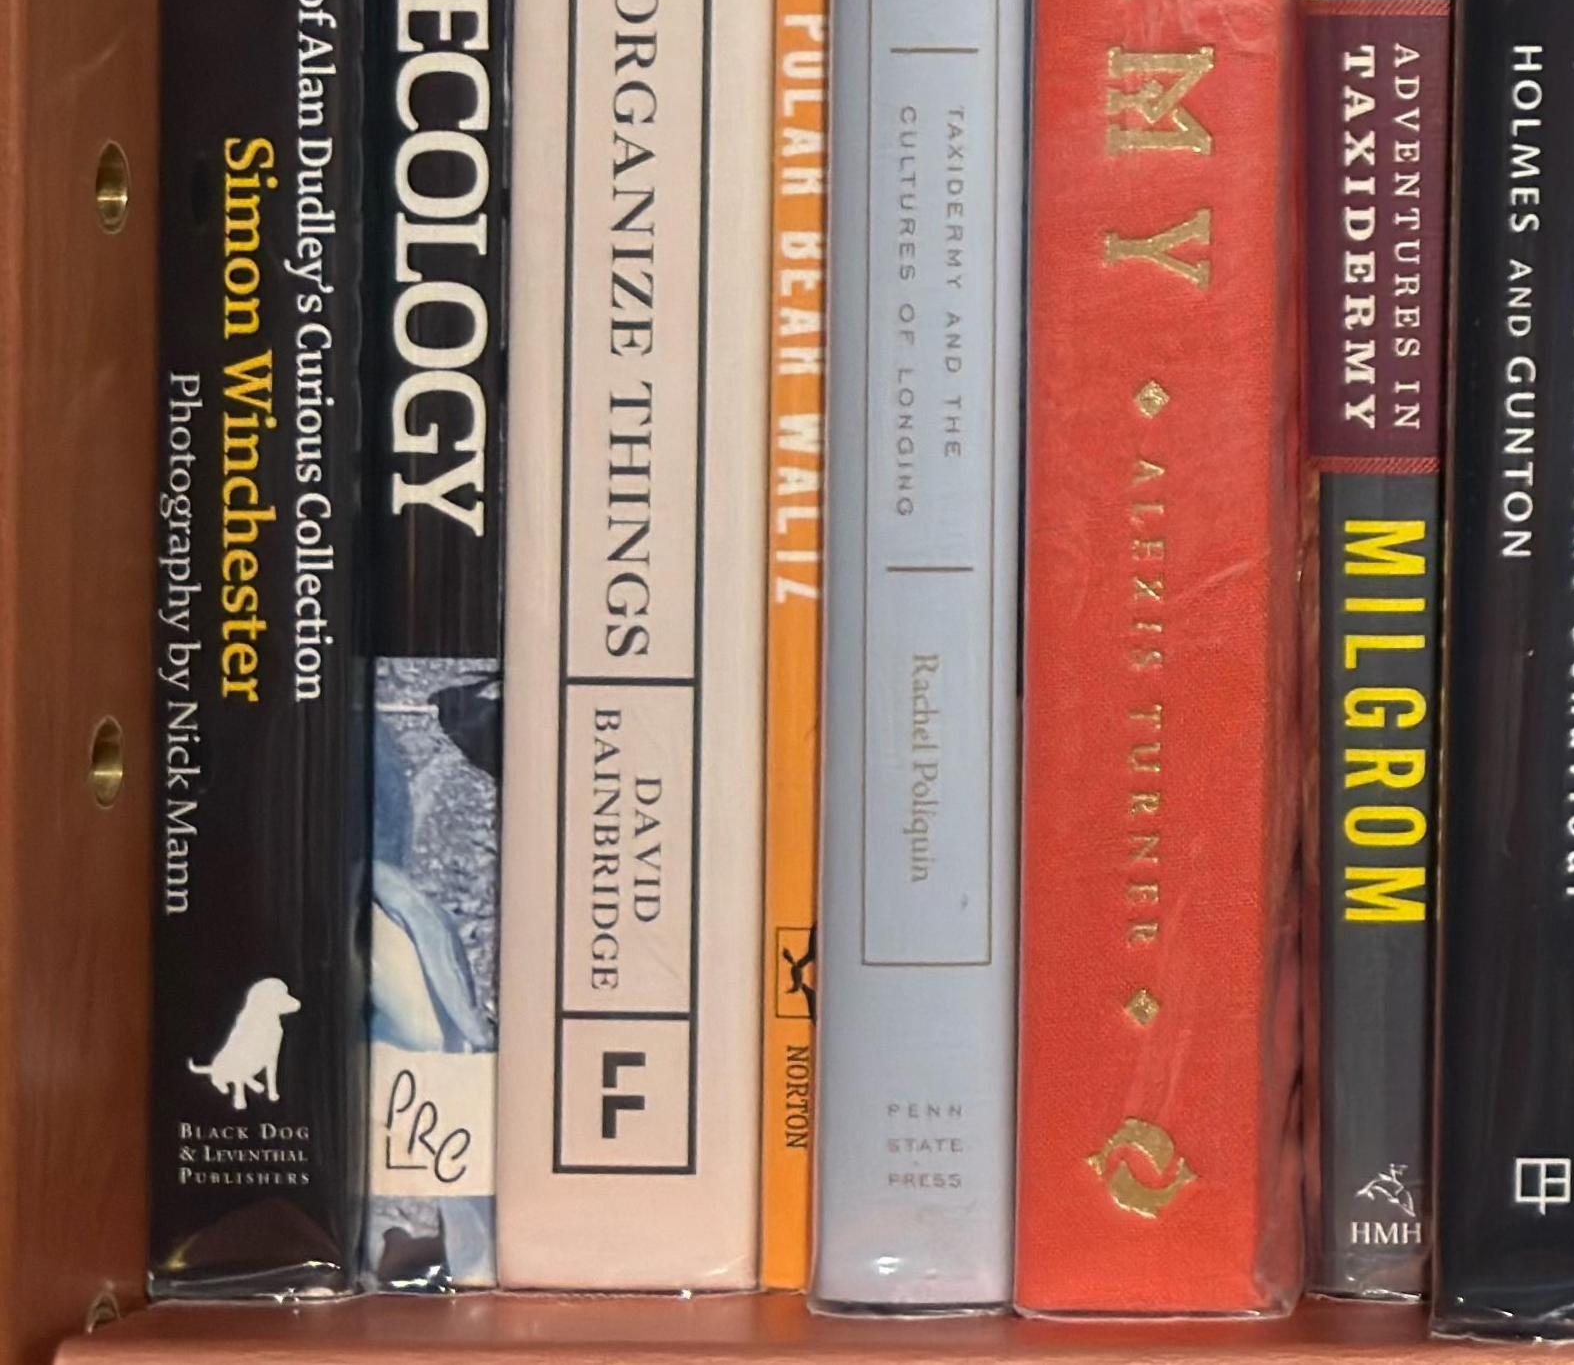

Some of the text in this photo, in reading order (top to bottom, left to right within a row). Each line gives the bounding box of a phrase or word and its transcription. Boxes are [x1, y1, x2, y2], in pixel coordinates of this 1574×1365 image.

[298, 33, 336, 129] Alan
[288, 137, 335, 313] Dudley's
[895, 105, 918, 517] CULTURES OF LONGING
[943, 109, 965, 459] TAXIDERMY AND THE
[1343, 44, 1377, 429] TAXIDERMY
[1393, 43, 1421, 429] ADVENTURES IN
[1501, 45, 1543, 557] HOLMES AND GUNTON
[219, 137, 276, 703] Simon Winchester
[295, 323, 333, 483] Curious
[295, 492, 331, 702] Collection
[605, 381, 653, 657] THINGS
[157, 373, 203, 914] Photography by Nick Mann
[1126, 457, 1167, 949] ALEXIS TURNER
[1343, 520, 1426, 924] MILGROM
[590, 708, 622, 991] BAINBRIDGE
[633, 777, 663, 924] DAVID
[902, 654, 940, 883] Rachel Poliquin
[179, 1144, 308, 1162] & LEVENTHAL
[179, 1166, 310, 1185] PUBLISHERS
[180, 1122, 309, 1140] BLACK DOG
[785, 1044, 810, 1150] NORTON
[887, 1102, 962, 1119] PENN
[887, 1137, 963, 1153] STATE
[887, 1173, 962, 1188] PRESS
[1350, 1221, 1423, 1245] HMH
